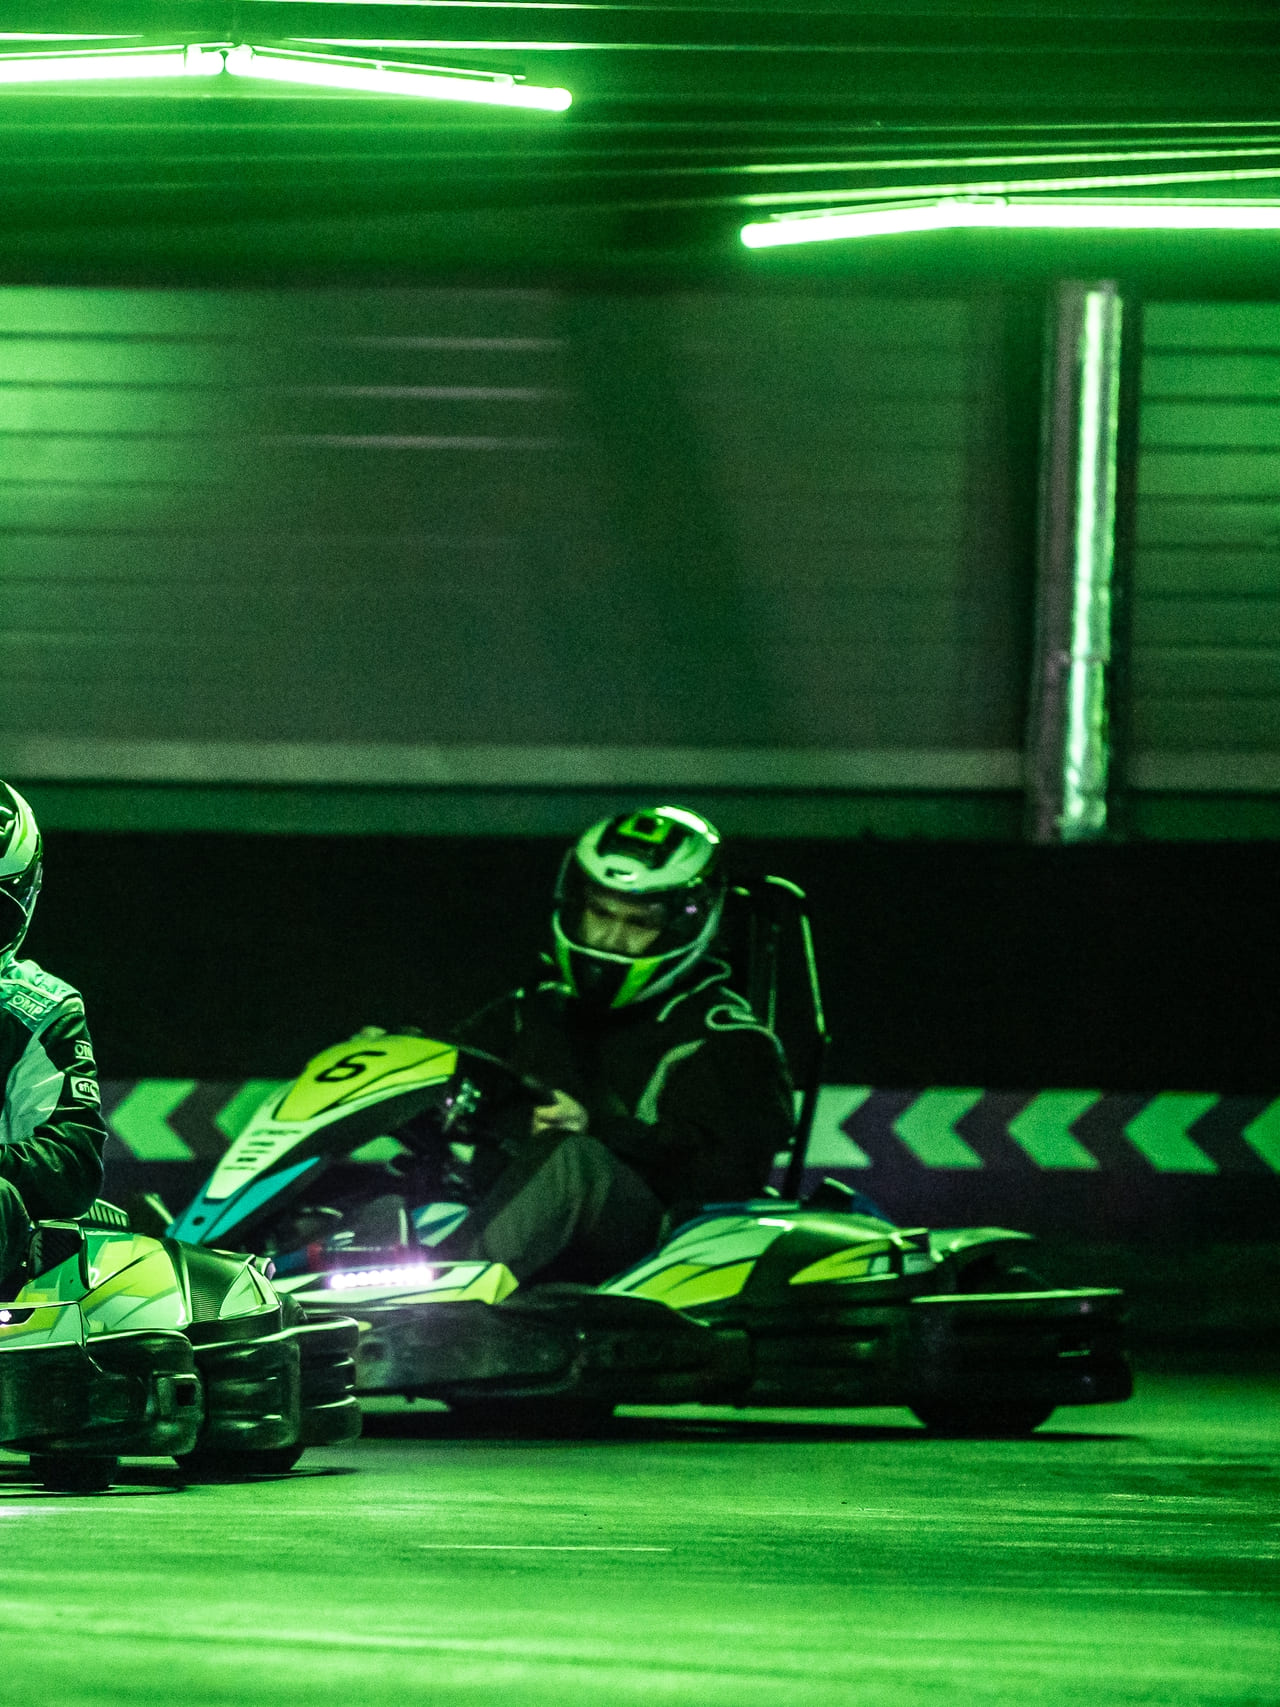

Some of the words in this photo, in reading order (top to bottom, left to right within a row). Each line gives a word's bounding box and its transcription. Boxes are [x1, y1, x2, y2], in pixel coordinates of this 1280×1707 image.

[12, 995, 45, 1016] OMP
[74, 1043, 93, 1057] OM
[314, 1050, 387, 1083] 6
